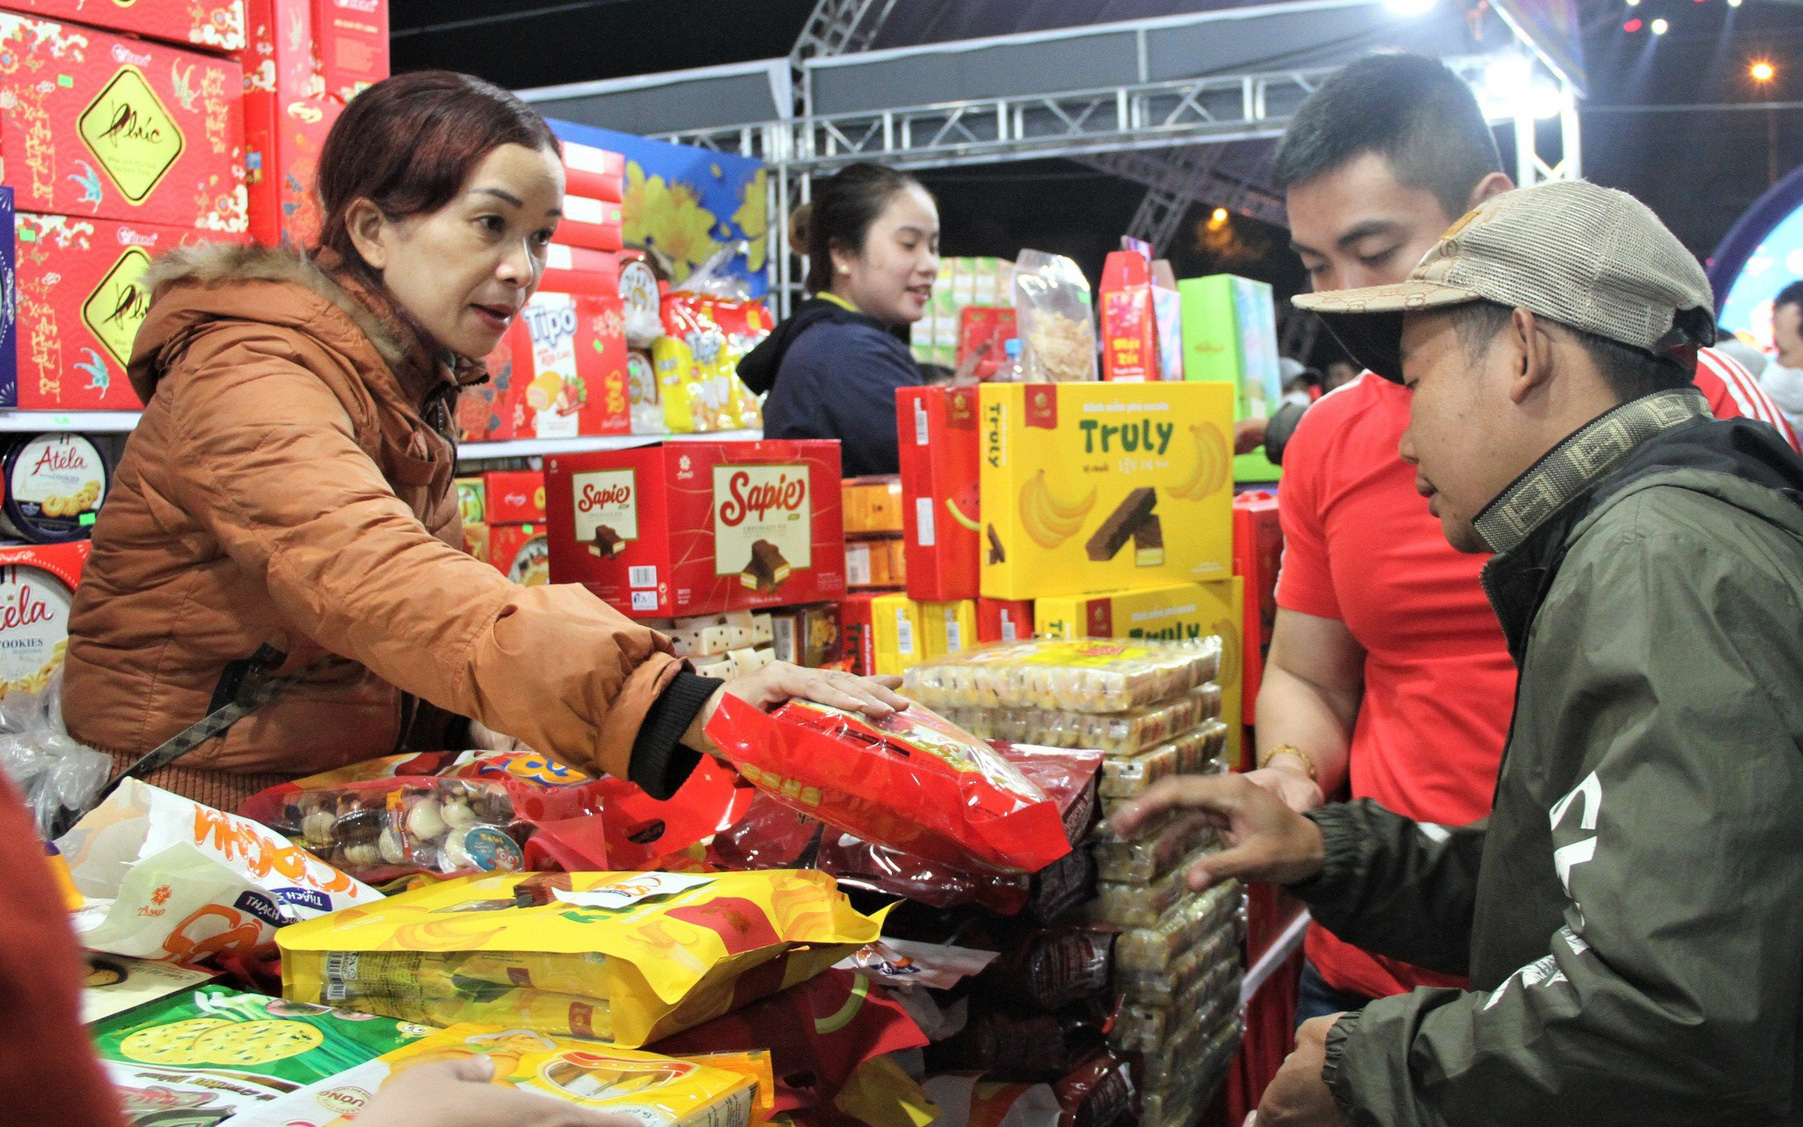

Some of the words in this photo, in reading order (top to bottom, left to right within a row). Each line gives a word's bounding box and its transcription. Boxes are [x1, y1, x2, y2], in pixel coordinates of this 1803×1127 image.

[523, 305, 577, 347] Tipo
[988, 402, 1000, 468] Truly
[1079, 418, 1173, 455] Truly
[578, 483, 631, 513] Sapie
[720, 471, 805, 526] Sapie
[0, 638, 44, 648] OOKIES
